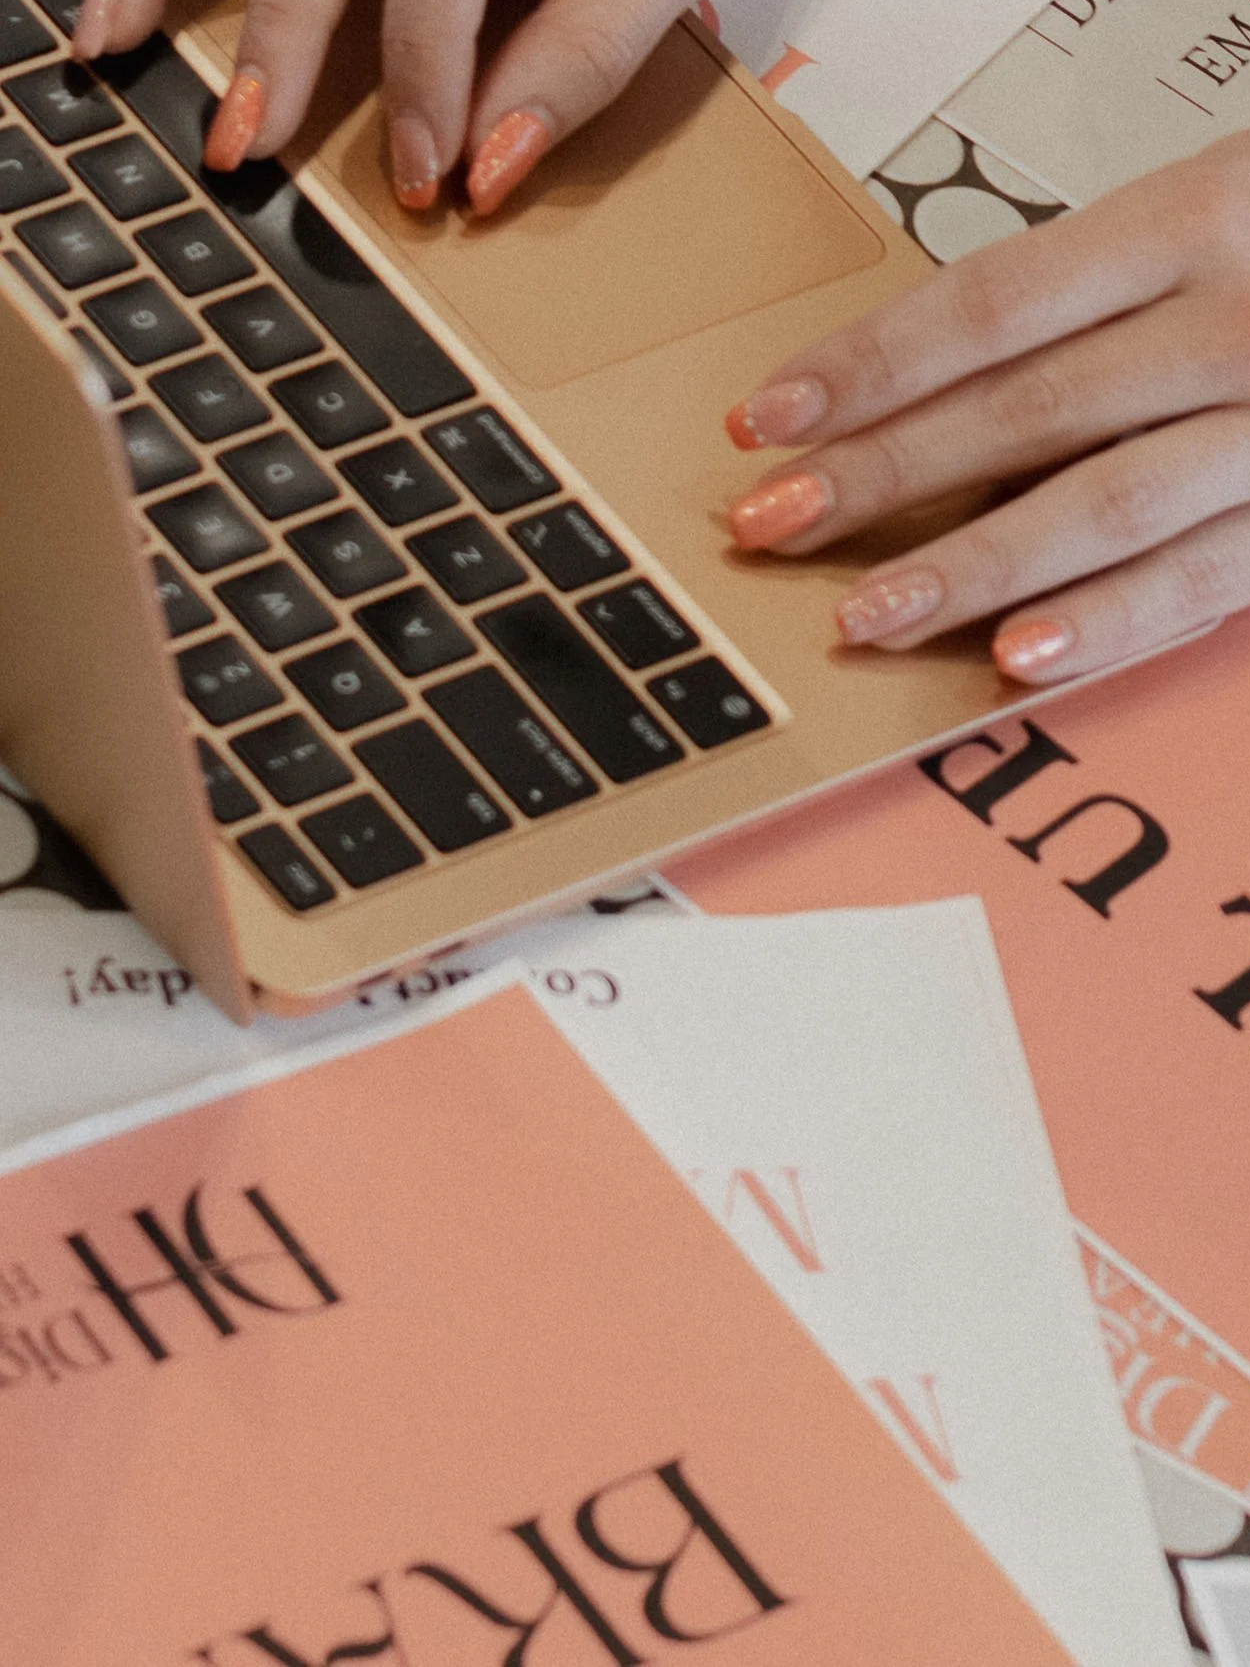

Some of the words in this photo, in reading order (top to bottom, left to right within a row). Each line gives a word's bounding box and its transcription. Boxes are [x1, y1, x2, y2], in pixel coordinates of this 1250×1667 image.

[114, 163, 145, 184] N
[182, 240, 213, 262] B
[247, 318, 276, 339] V
[196, 389, 228, 407] F
[316, 391, 346, 413] C
[264, 462, 296, 485] D
[383, 468, 417, 491] X
[195, 515, 224, 536] E
[331, 540, 363, 563] S
[451, 543, 485, 570] Z
[258, 591, 295, 621] W
[403, 615, 433, 639] A
[330, 670, 363, 697] Q
[916, 719, 1172, 920] UP
[64, 952, 196, 1008] day!
